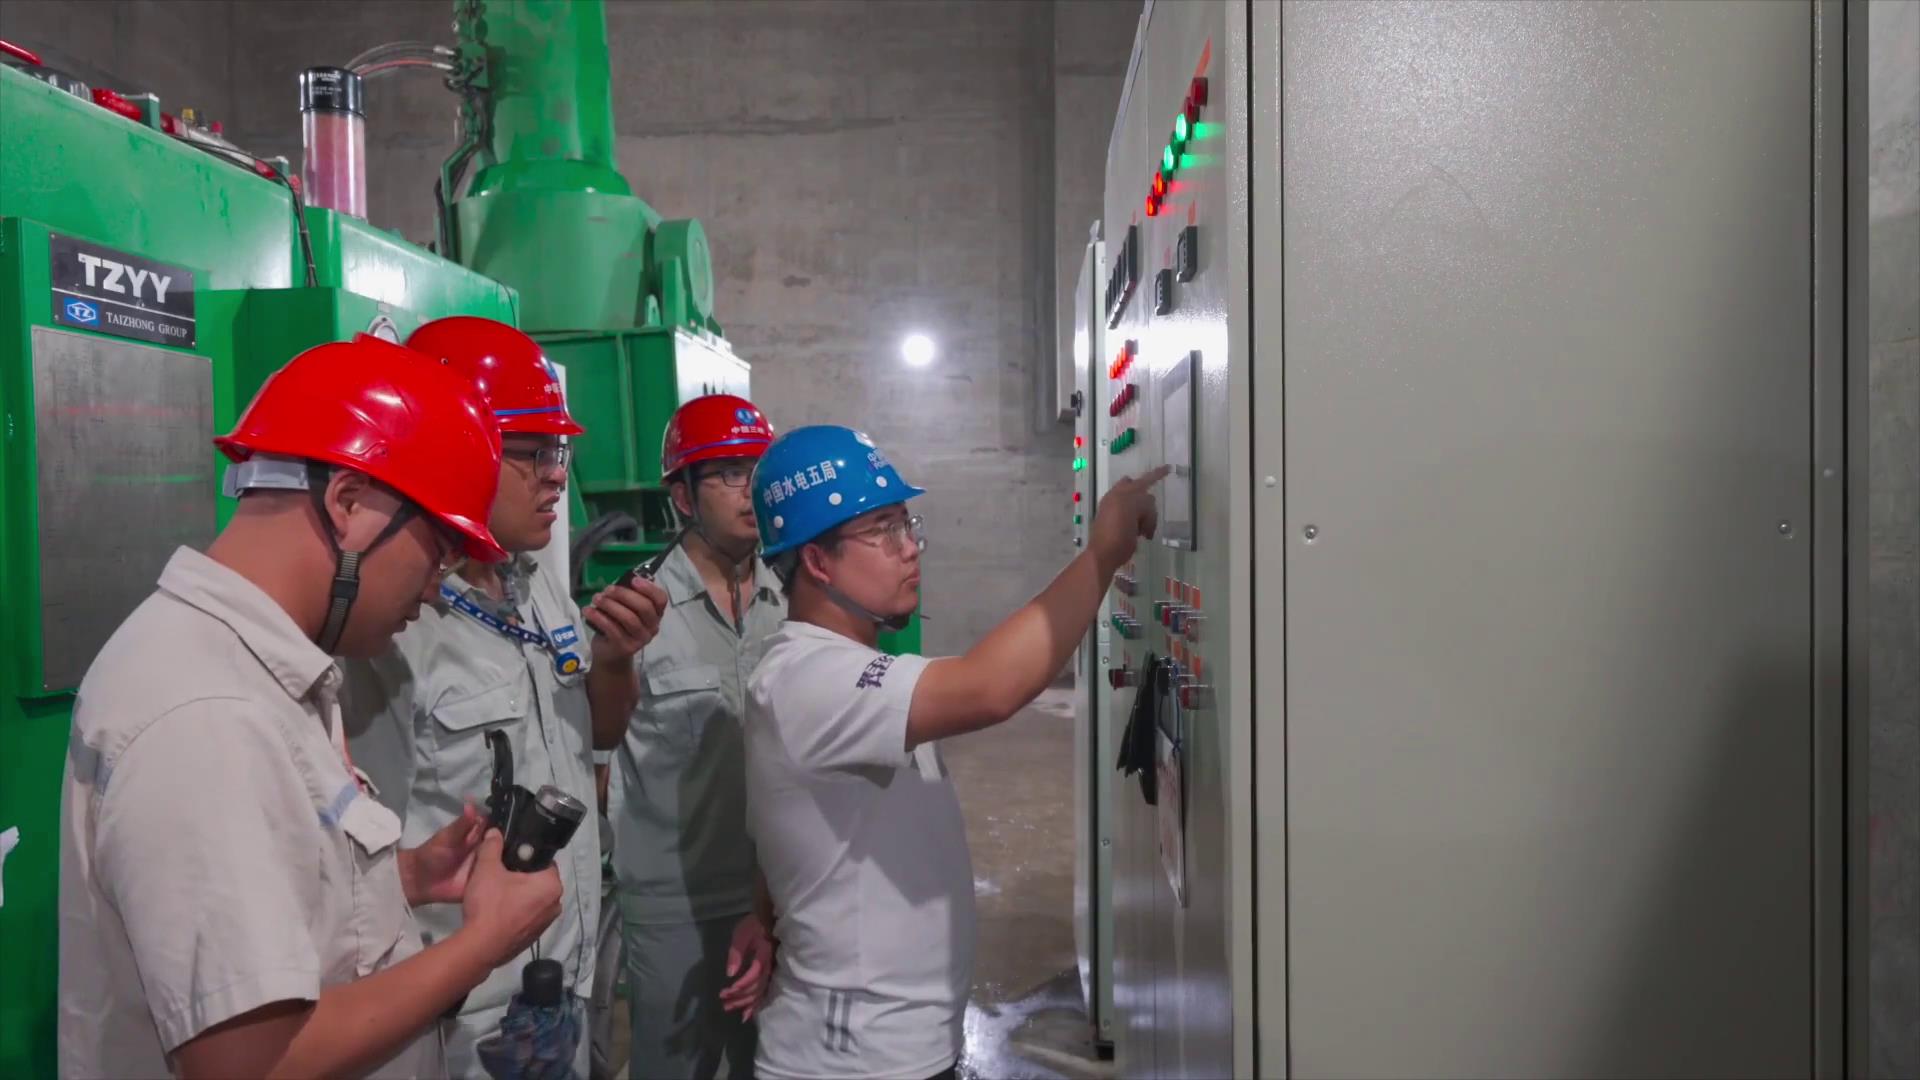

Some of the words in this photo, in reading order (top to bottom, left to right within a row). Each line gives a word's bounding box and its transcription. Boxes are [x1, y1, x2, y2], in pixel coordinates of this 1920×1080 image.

[78, 253, 172, 303] TZYY
[71, 305, 92, 318] TZ
[106, 312, 155, 332] TAIZHONG
[158, 323, 188, 338] GROUP
[763, 460, 838, 508] 中国水电五局
